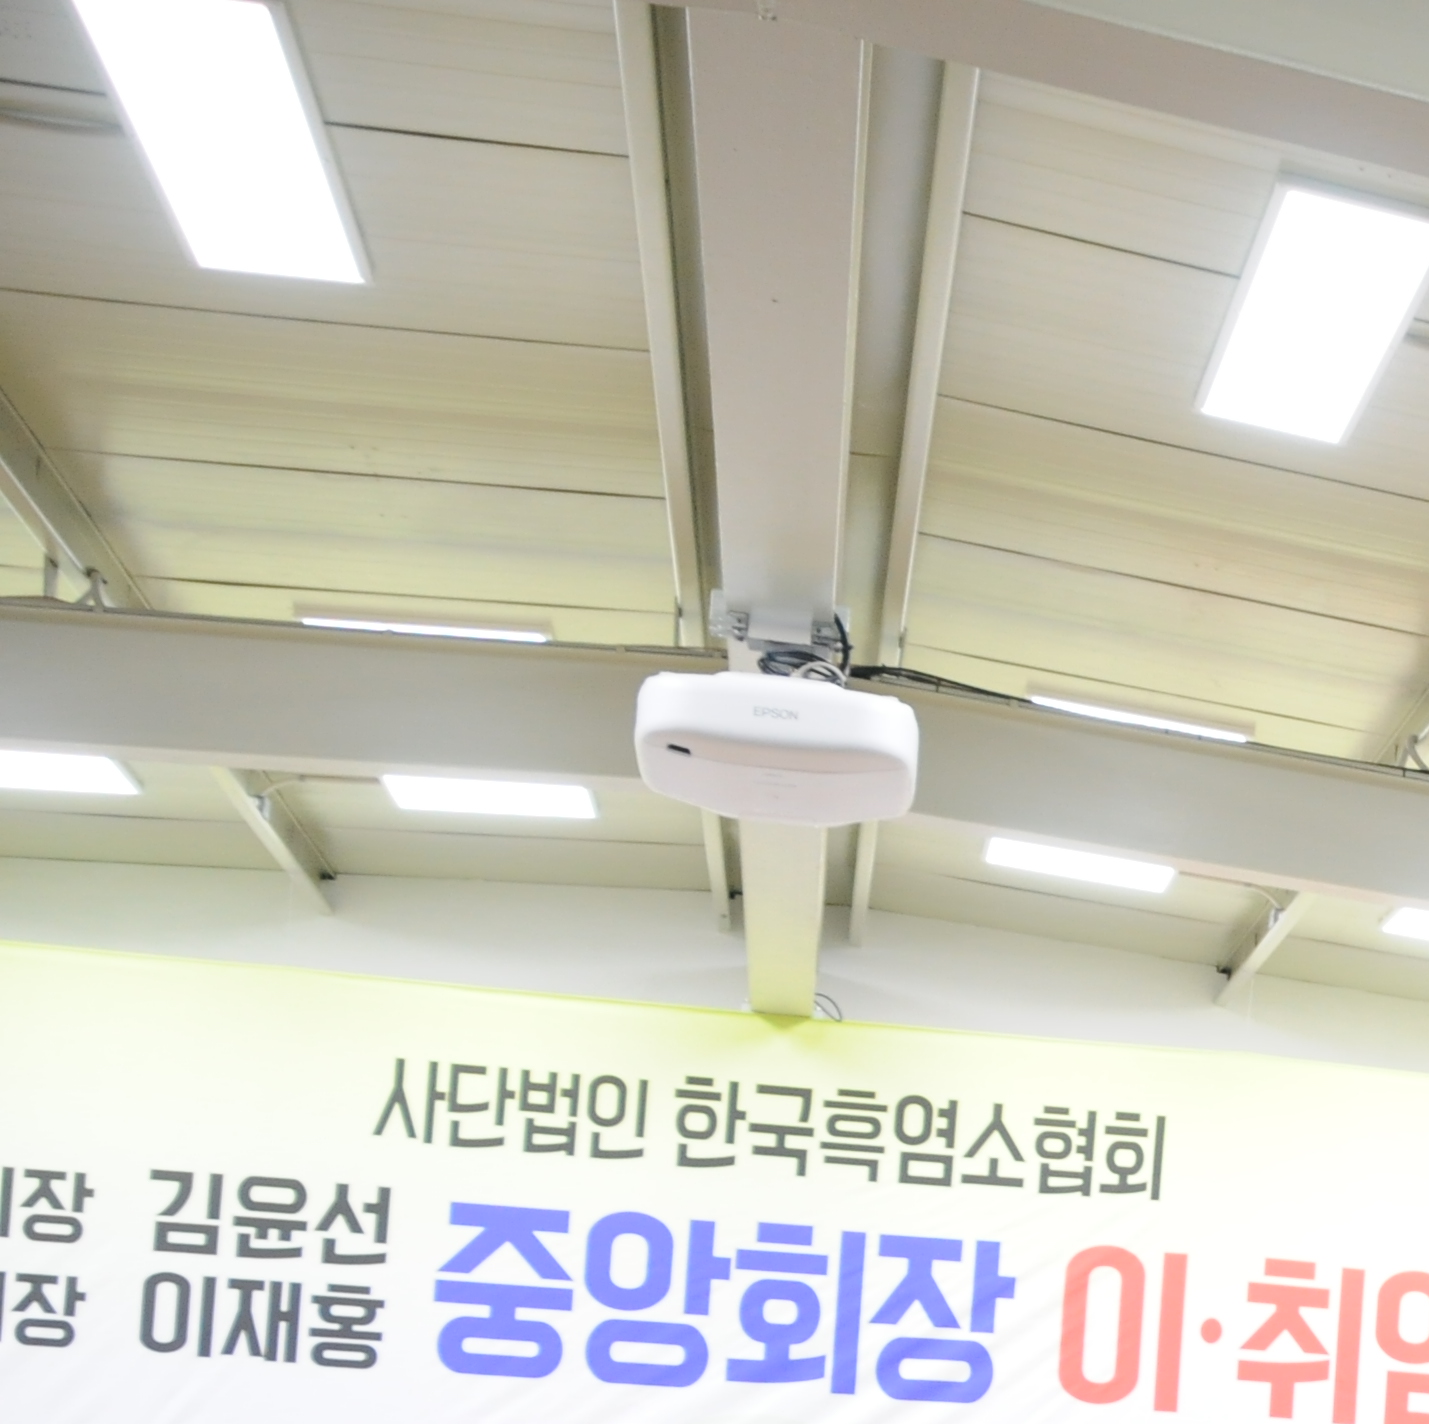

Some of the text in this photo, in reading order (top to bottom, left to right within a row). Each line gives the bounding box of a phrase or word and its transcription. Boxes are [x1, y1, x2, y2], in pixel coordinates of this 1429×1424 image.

[753, 706, 799, 721] EPSON
[372, 1056, 1167, 1201] 사단법인 한국흑염소협회
[148, 1168, 392, 1266] 김윤선
[0, 1271, 386, 1370] 장 이재홍
[433, 1201, 1015, 1404] 중앙회장
